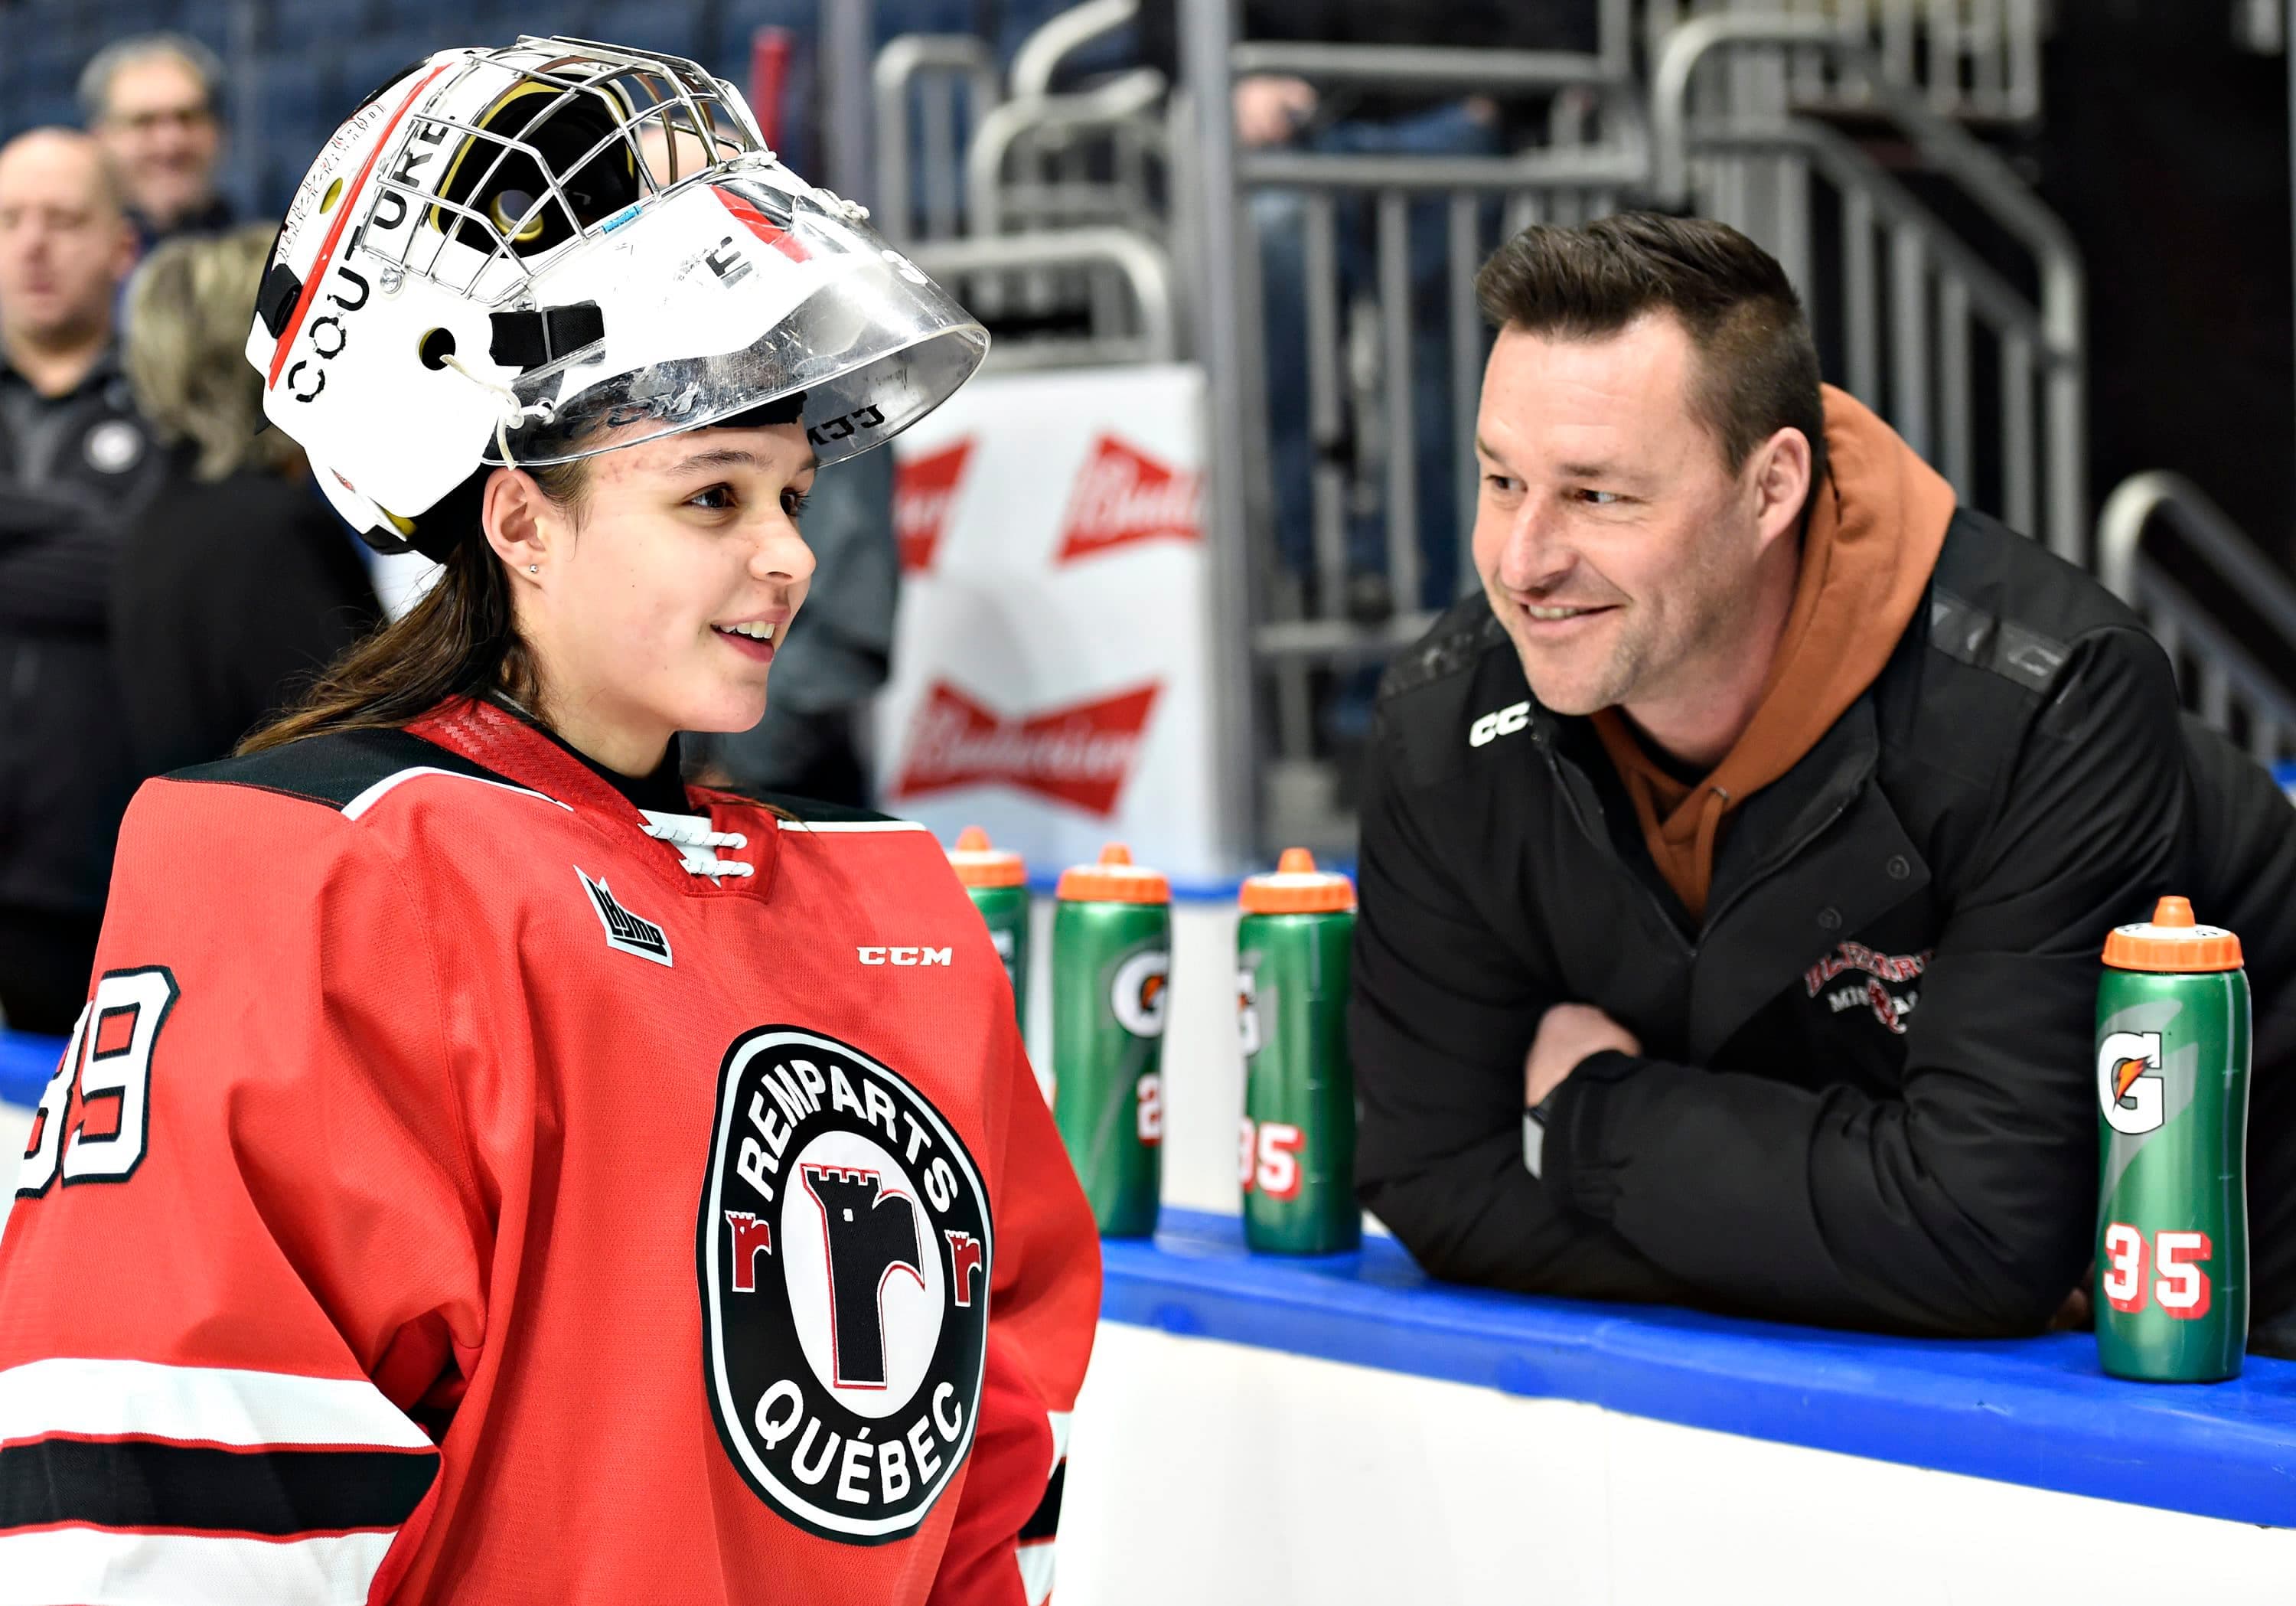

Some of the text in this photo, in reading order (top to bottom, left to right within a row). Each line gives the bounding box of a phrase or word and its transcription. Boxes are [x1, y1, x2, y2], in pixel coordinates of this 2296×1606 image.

[856, 945, 954, 967] CCM
[2098, 1030, 2166, 1134] G
[735, 1058, 960, 1215] REMPARTS
[2102, 1222, 2213, 1320] 35
[753, 1377, 964, 1506] QUÉBEC
